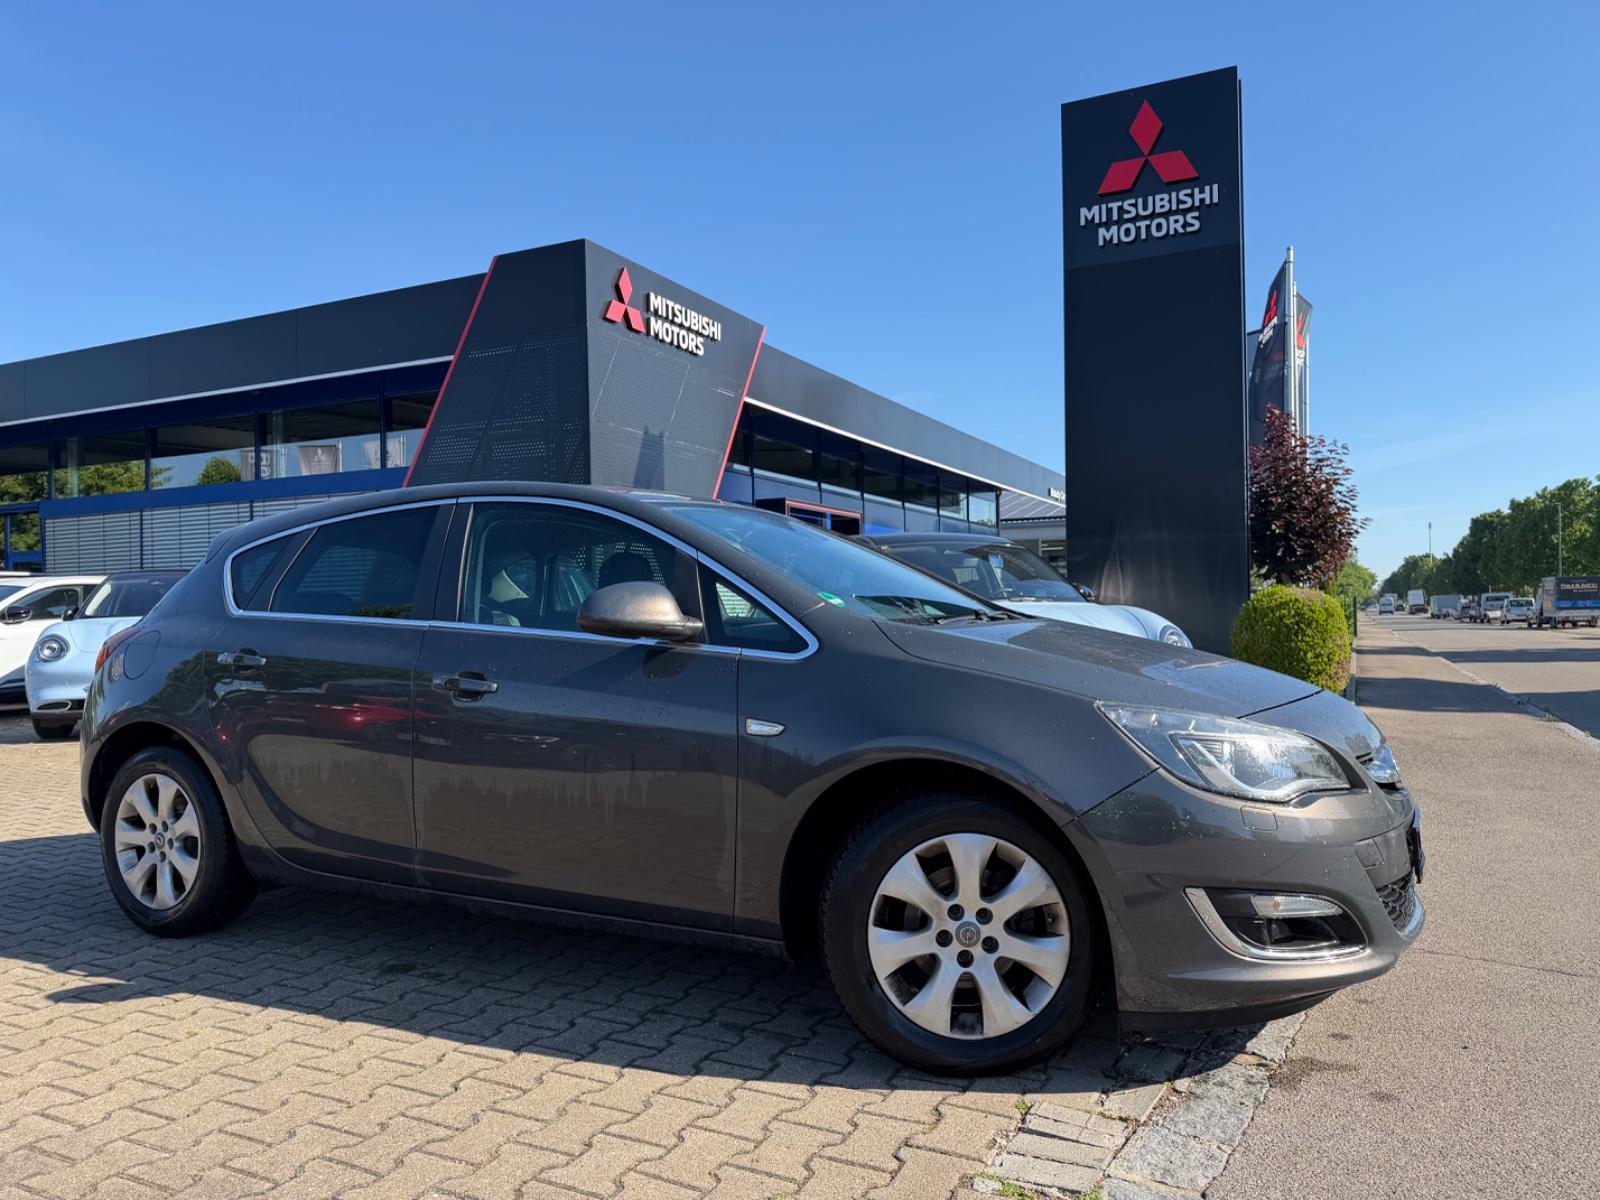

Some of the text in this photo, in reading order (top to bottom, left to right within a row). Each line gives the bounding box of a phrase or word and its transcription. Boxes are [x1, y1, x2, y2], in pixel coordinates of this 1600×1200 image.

[1079, 183, 1219, 226] MITSUBISHI
[1098, 212, 1200, 246] MOTORS
[649, 292, 721, 341] MITSUBISHI
[650, 316, 704, 356] MOTORS
